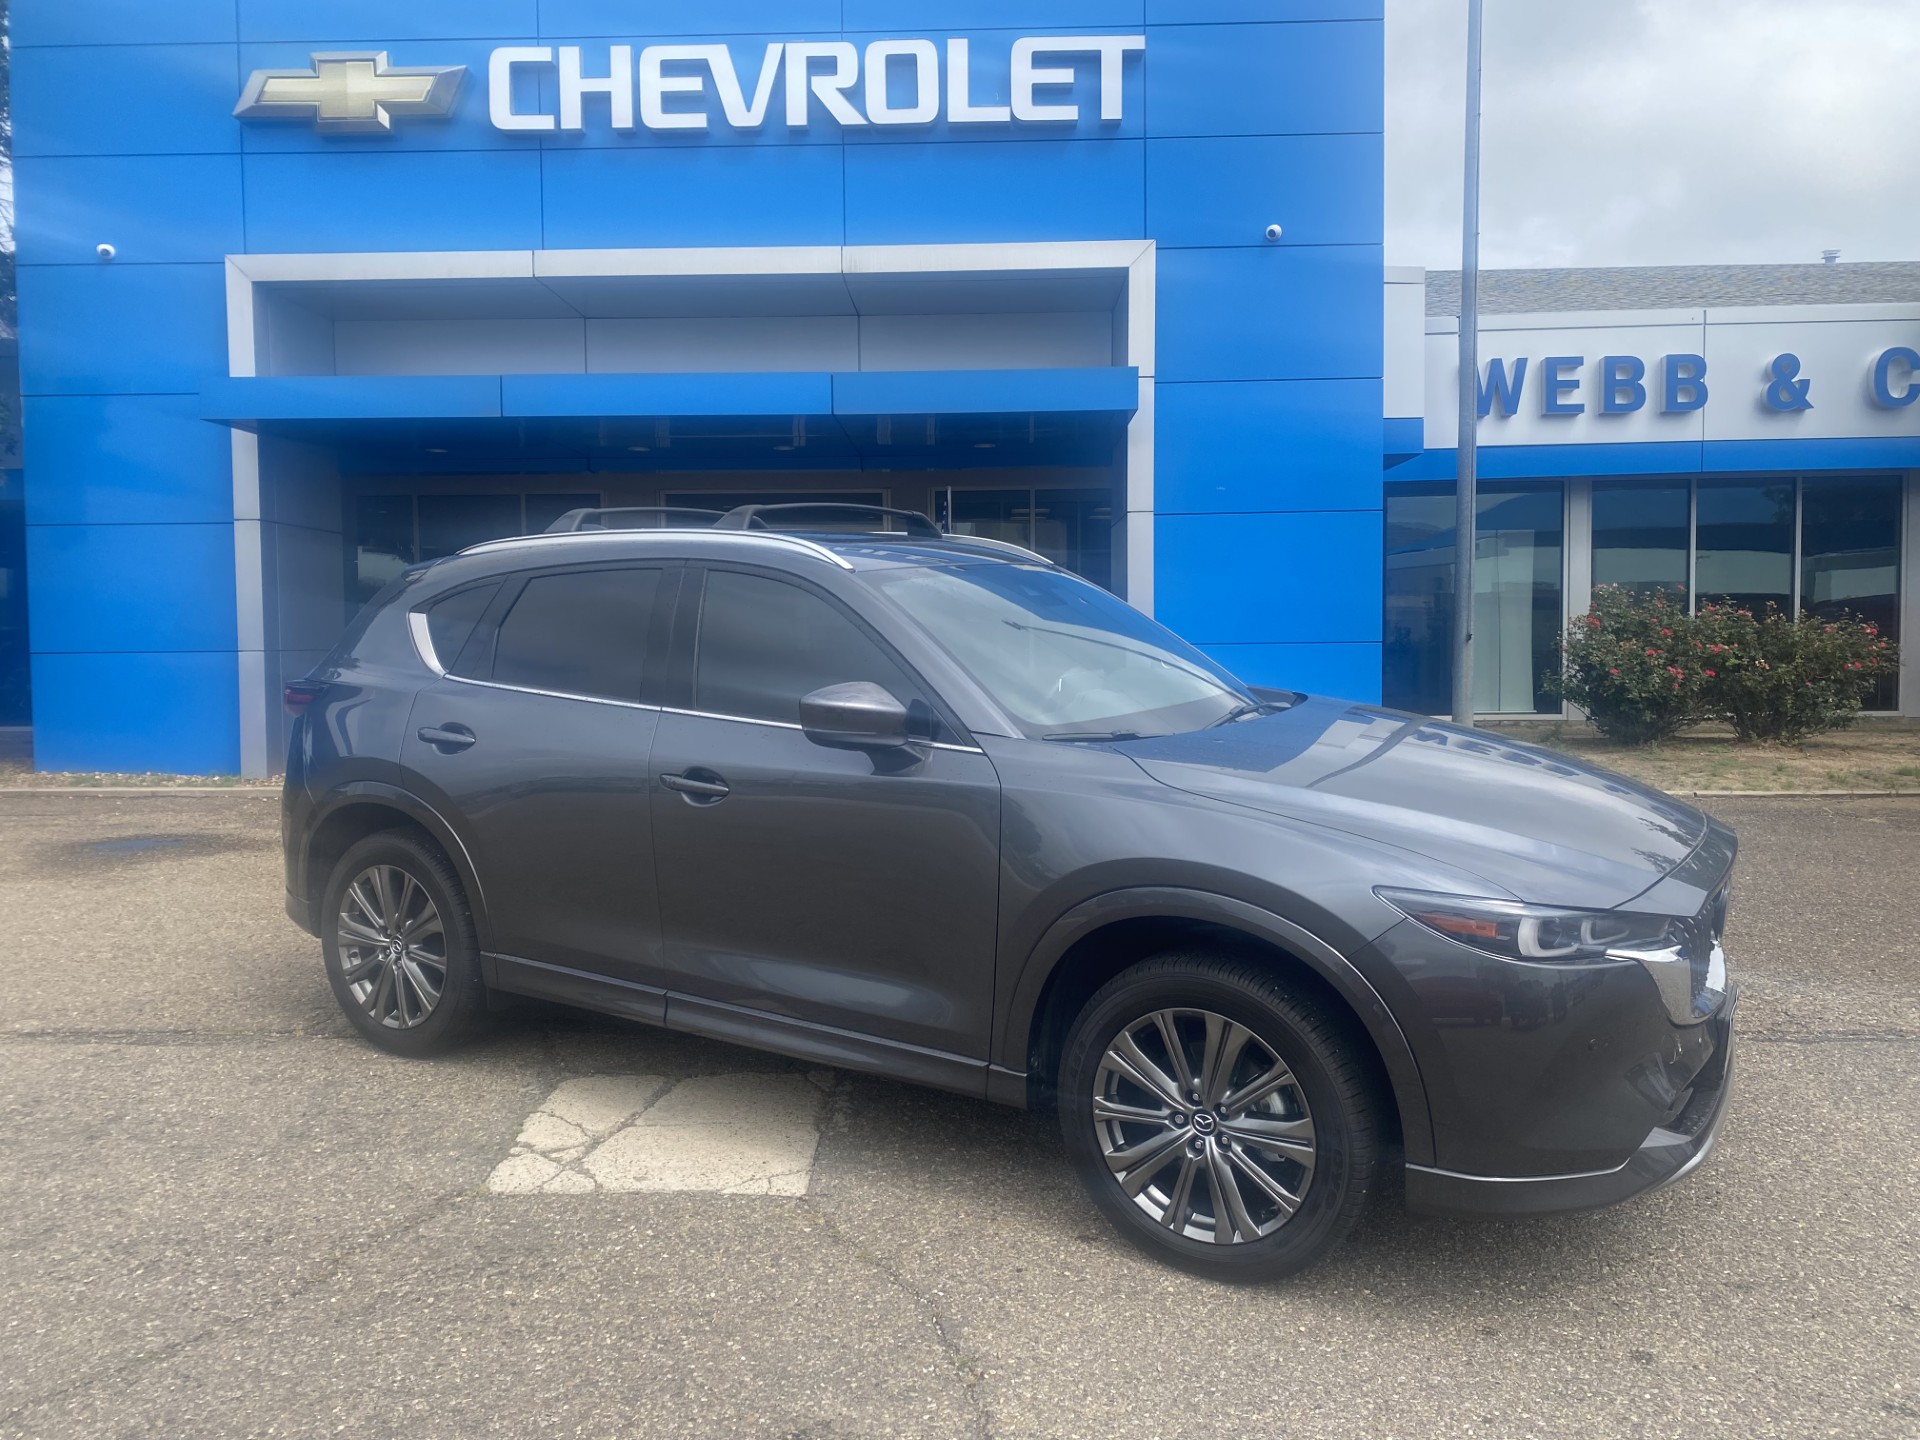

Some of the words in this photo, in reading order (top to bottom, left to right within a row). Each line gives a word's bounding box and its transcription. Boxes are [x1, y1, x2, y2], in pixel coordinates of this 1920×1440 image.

[488, 35, 1146, 130] CHEVROLET
[1475, 354, 1709, 417] WEBB
[1764, 354, 1814, 411] &
